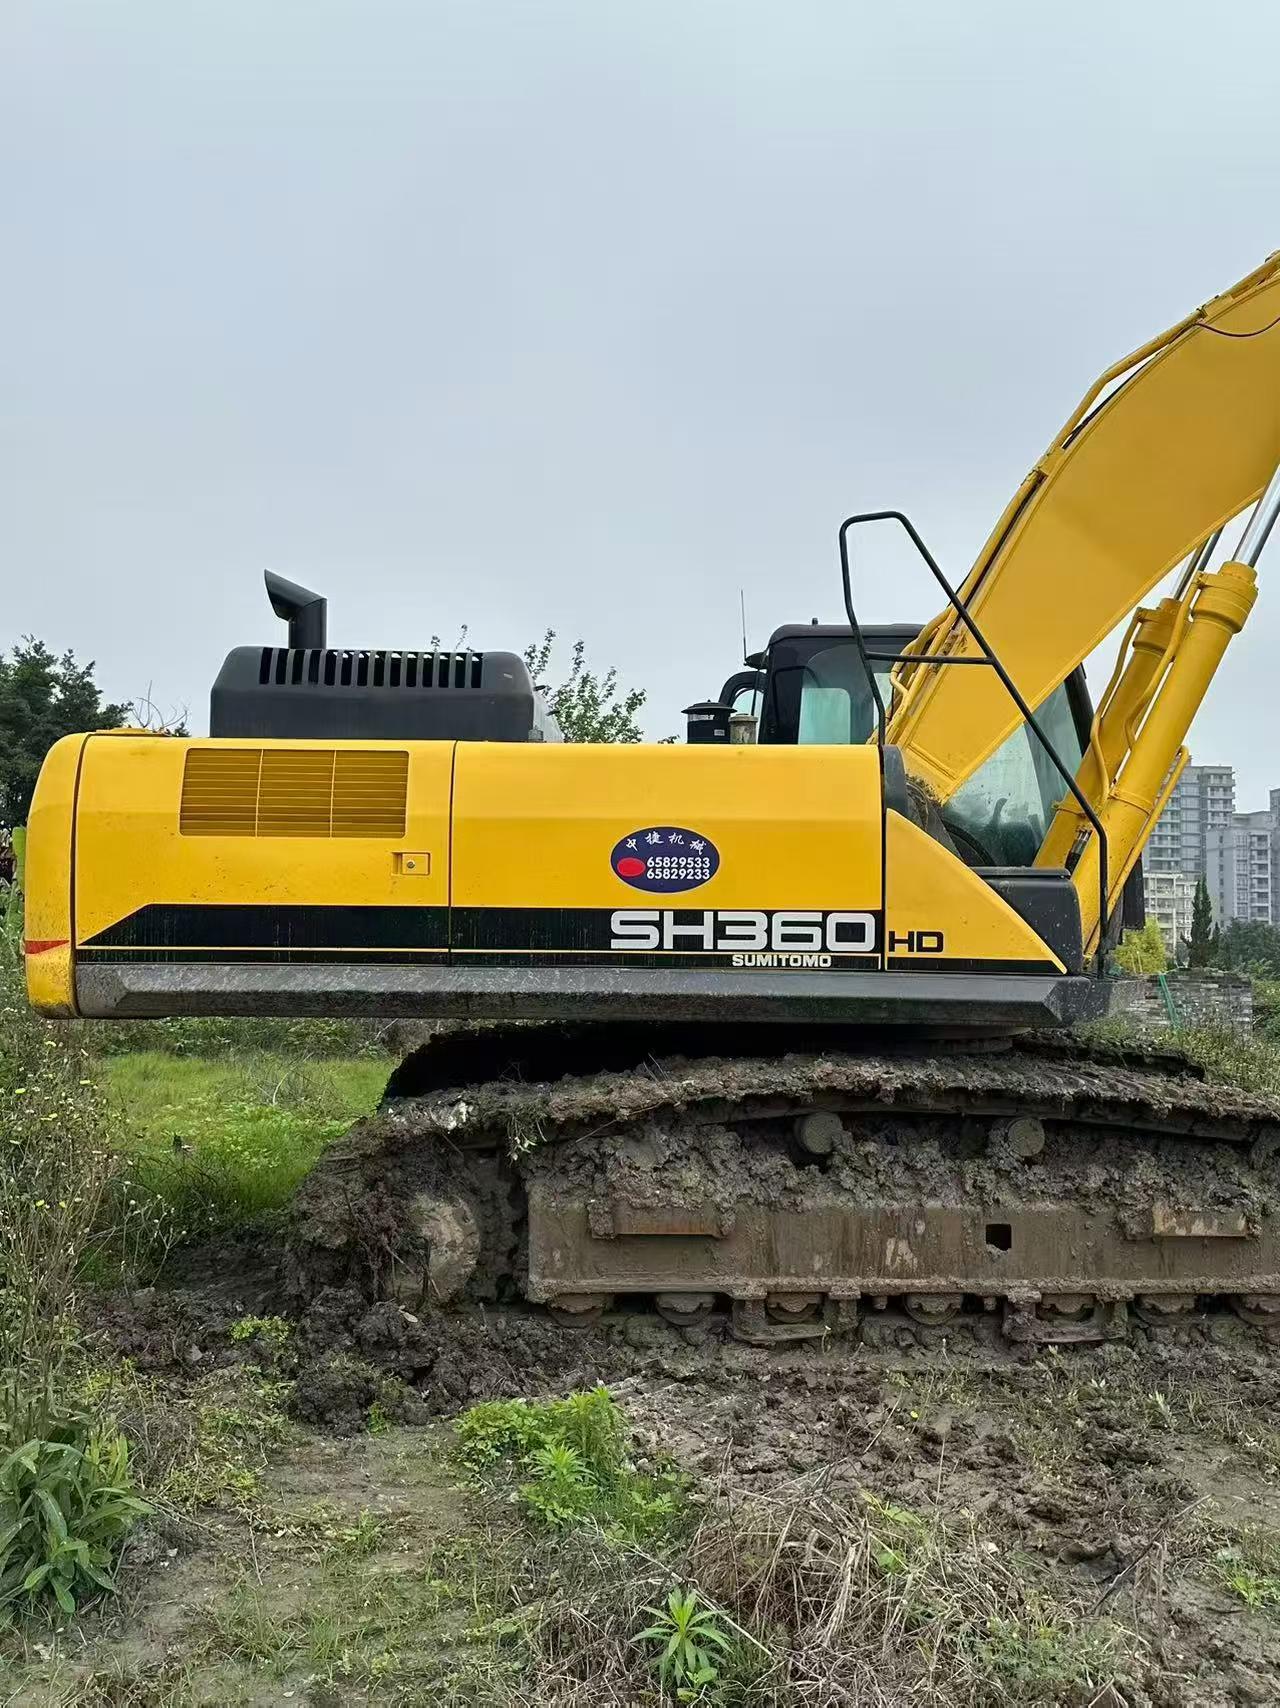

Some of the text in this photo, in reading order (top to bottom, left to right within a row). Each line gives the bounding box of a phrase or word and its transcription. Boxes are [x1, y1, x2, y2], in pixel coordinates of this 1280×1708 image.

[647, 856, 710, 868] 65829533
[647, 868, 710, 880] 65829233
[610, 911, 944, 953] SH360 HD
[732, 954, 832, 968] SUMITOMO
